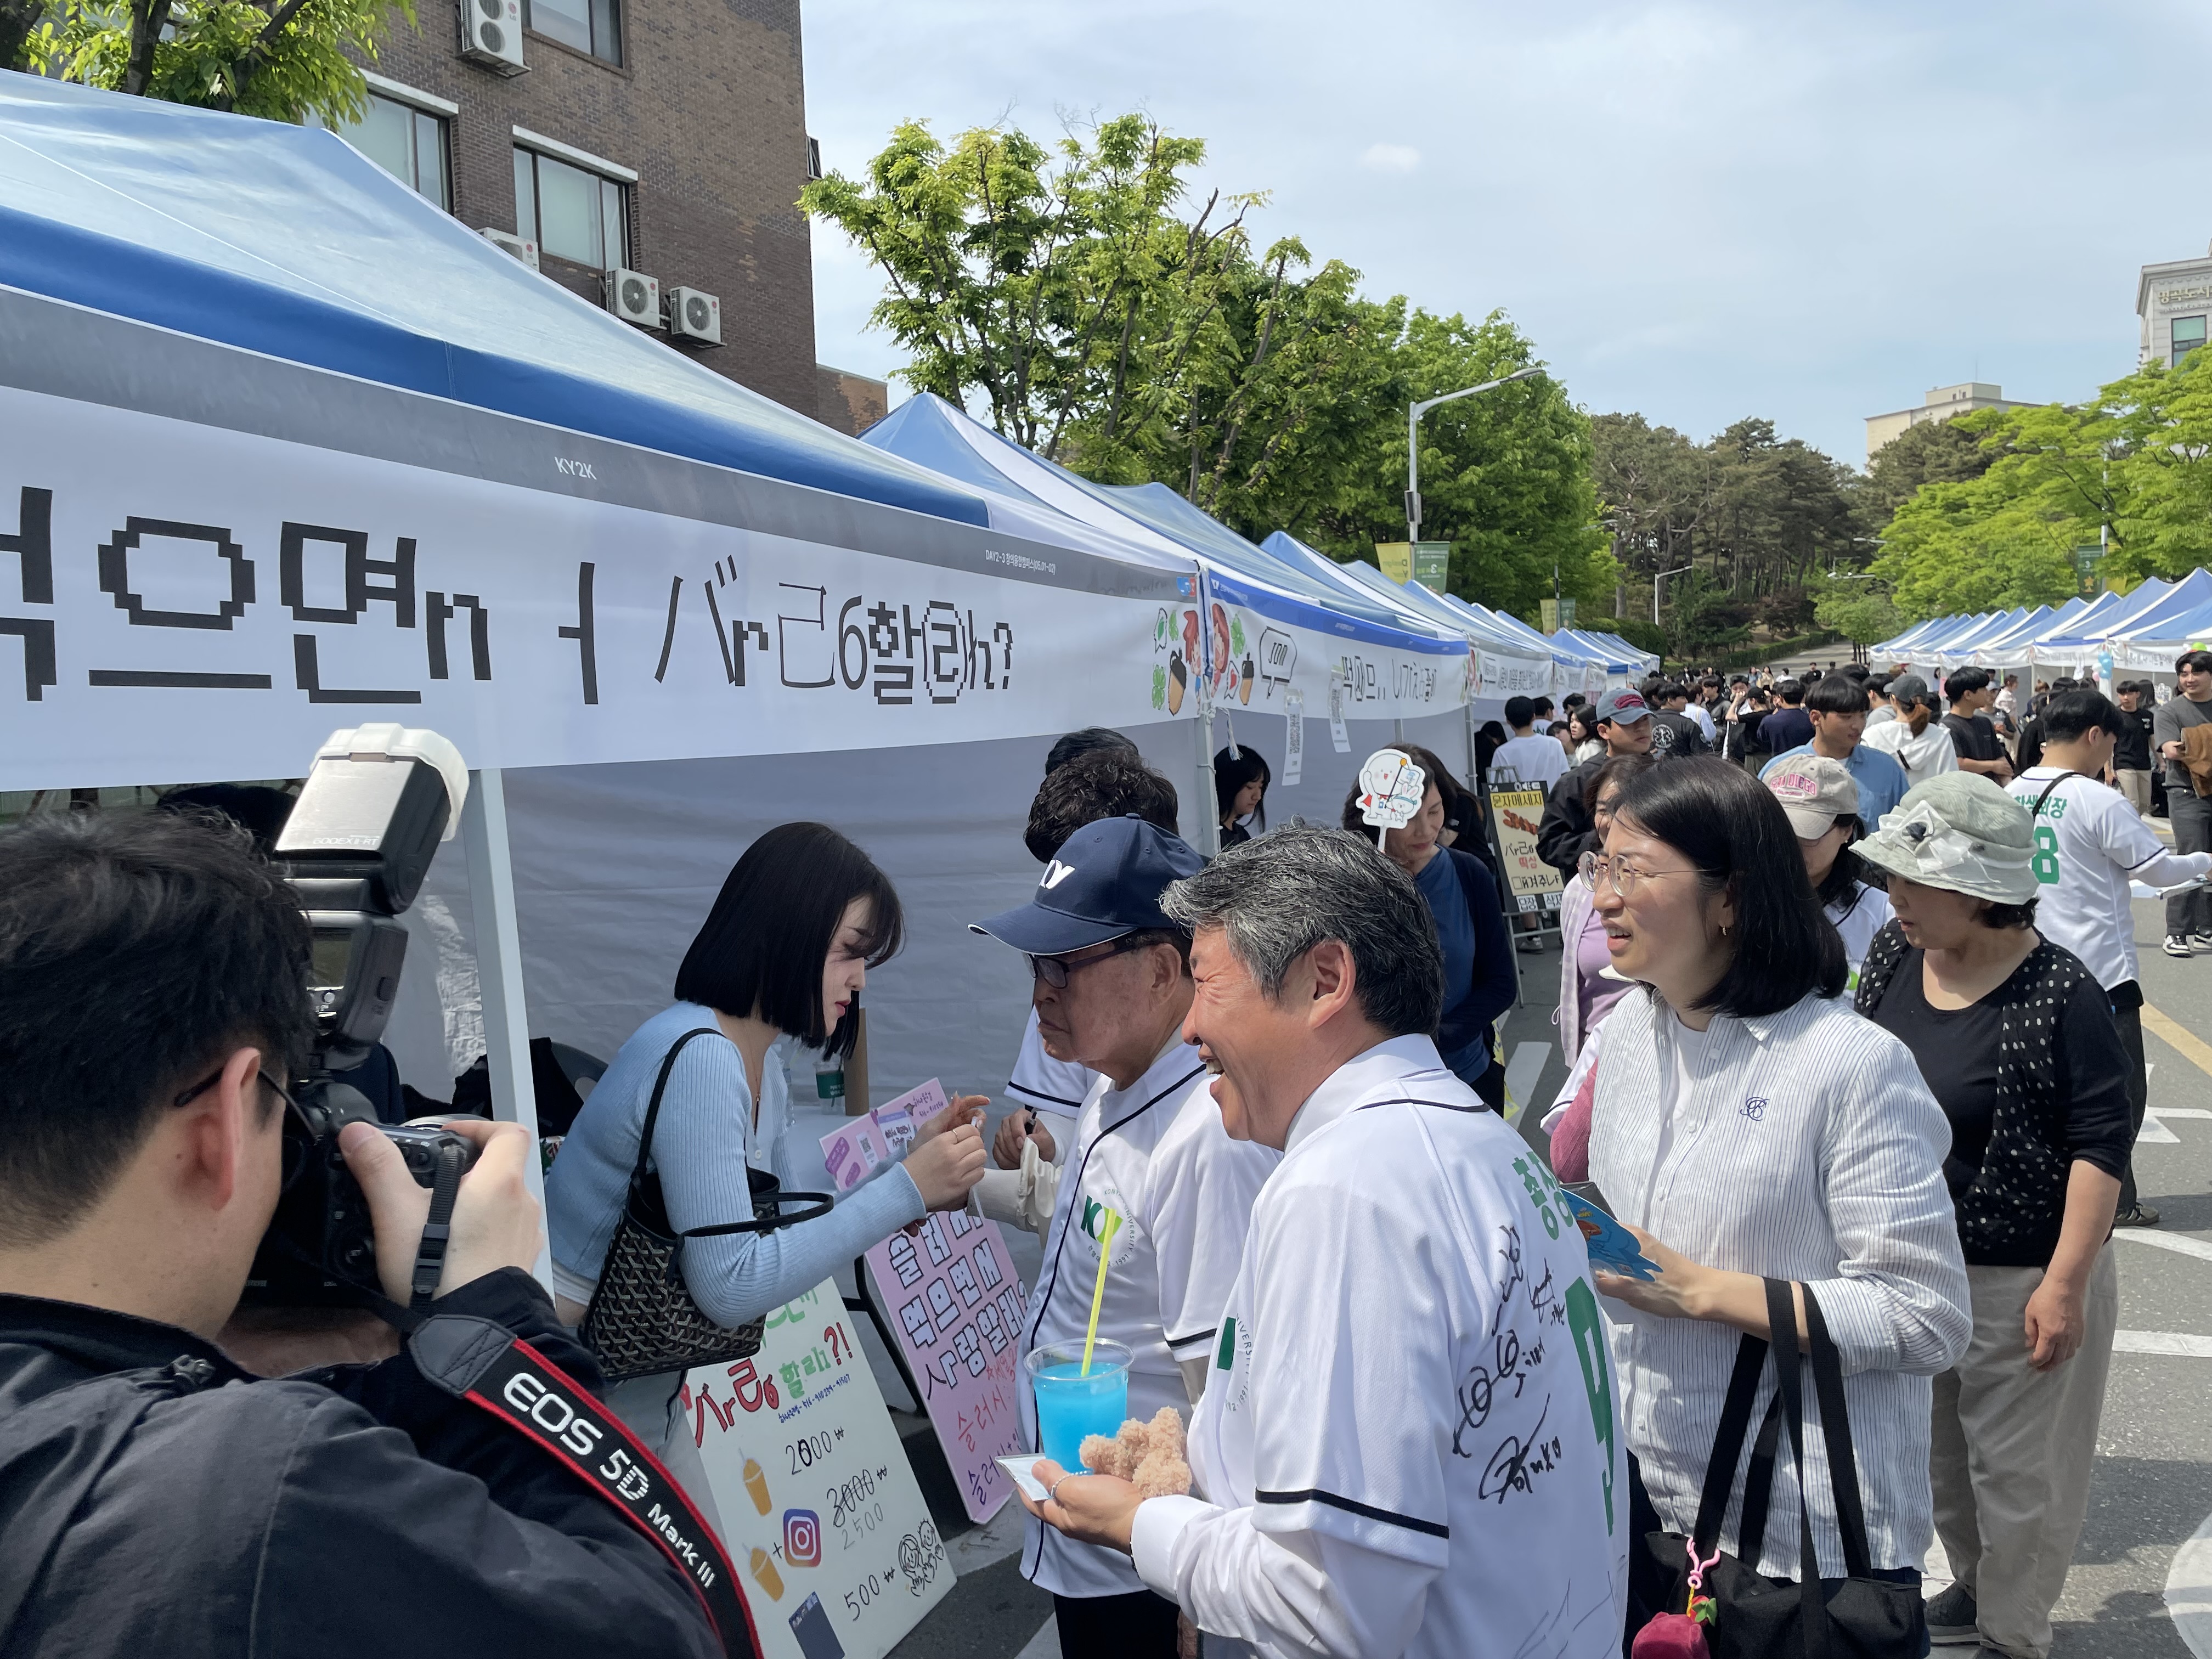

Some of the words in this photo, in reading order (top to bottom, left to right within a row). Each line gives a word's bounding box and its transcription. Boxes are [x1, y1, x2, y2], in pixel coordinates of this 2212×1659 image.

[2158, 285, 2212, 304] 명곡도서
[554, 456, 597, 480] KY2K
[1787, 773, 1817, 796] DIEGO
[1492, 793, 1543, 808] 문자메세지
[2032, 826, 2060, 884] 8
[1519, 896, 1537, 911] 답장
[1115, 1254, 1130, 1266] 1991
[504, 1373, 603, 1455] EOS
[600, 1449, 650, 1500] 5D
[647, 1504, 699, 1566] Mark
[696, 1561, 715, 1588] III
[842, 1503, 884, 1550] 2500
